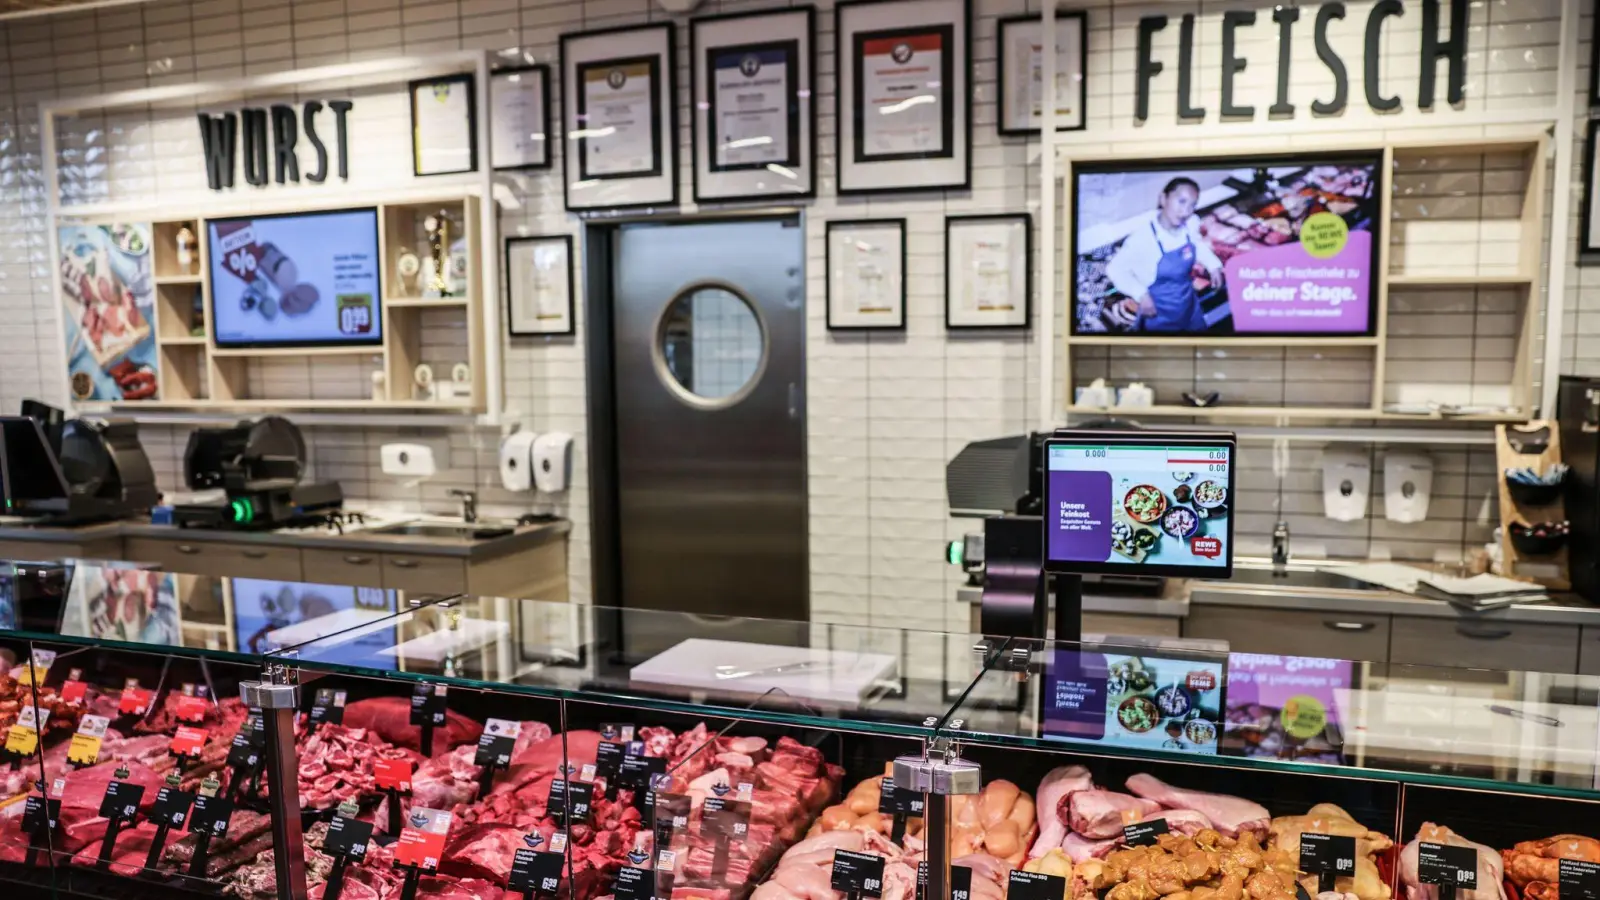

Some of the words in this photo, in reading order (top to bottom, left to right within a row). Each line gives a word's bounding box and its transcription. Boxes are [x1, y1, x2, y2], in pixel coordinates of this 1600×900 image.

[1136, 0, 1467, 121] FLEISCH
[198, 101, 353, 190] WURST
[1238, 267, 1267, 279] Mach
[1268, 267, 1283, 279] die
[1242, 282, 1297, 301] deiner
[1300, 281, 1358, 306] Stage.
[1085, 450, 1106, 458] 0.000
[1209, 451, 1226, 459] 0.00
[1209, 464, 1226, 472] 0.00
[1060, 501, 1086, 510] Unsere
[1060, 509, 1091, 519] Feinkost
